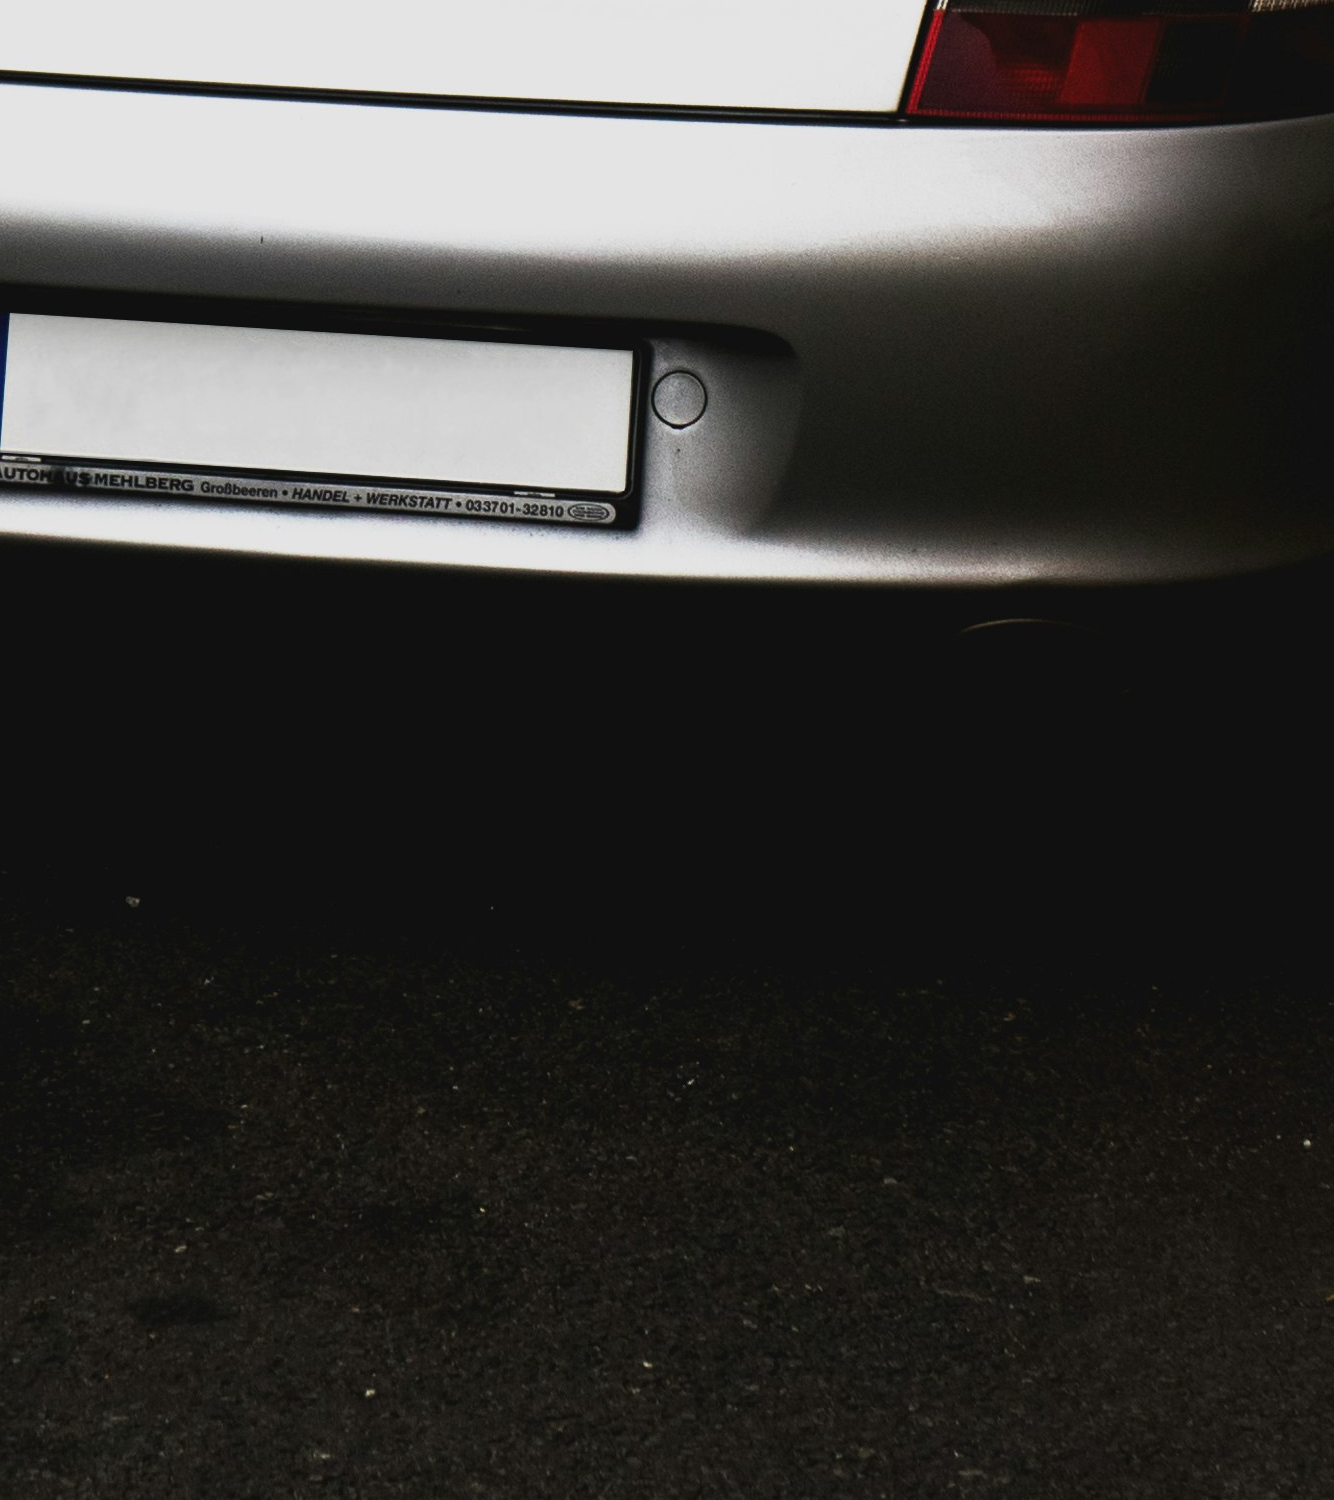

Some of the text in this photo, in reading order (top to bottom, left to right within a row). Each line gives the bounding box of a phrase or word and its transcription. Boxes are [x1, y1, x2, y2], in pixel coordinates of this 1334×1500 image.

[94, 473, 195, 492] MEHLBERG
[200, 480, 278, 498] Großbeeren
[291, 487, 350, 503] HANDEL
[366, 492, 453, 510] WERKSTATT
[465, 500, 564, 518] 033701-32810
